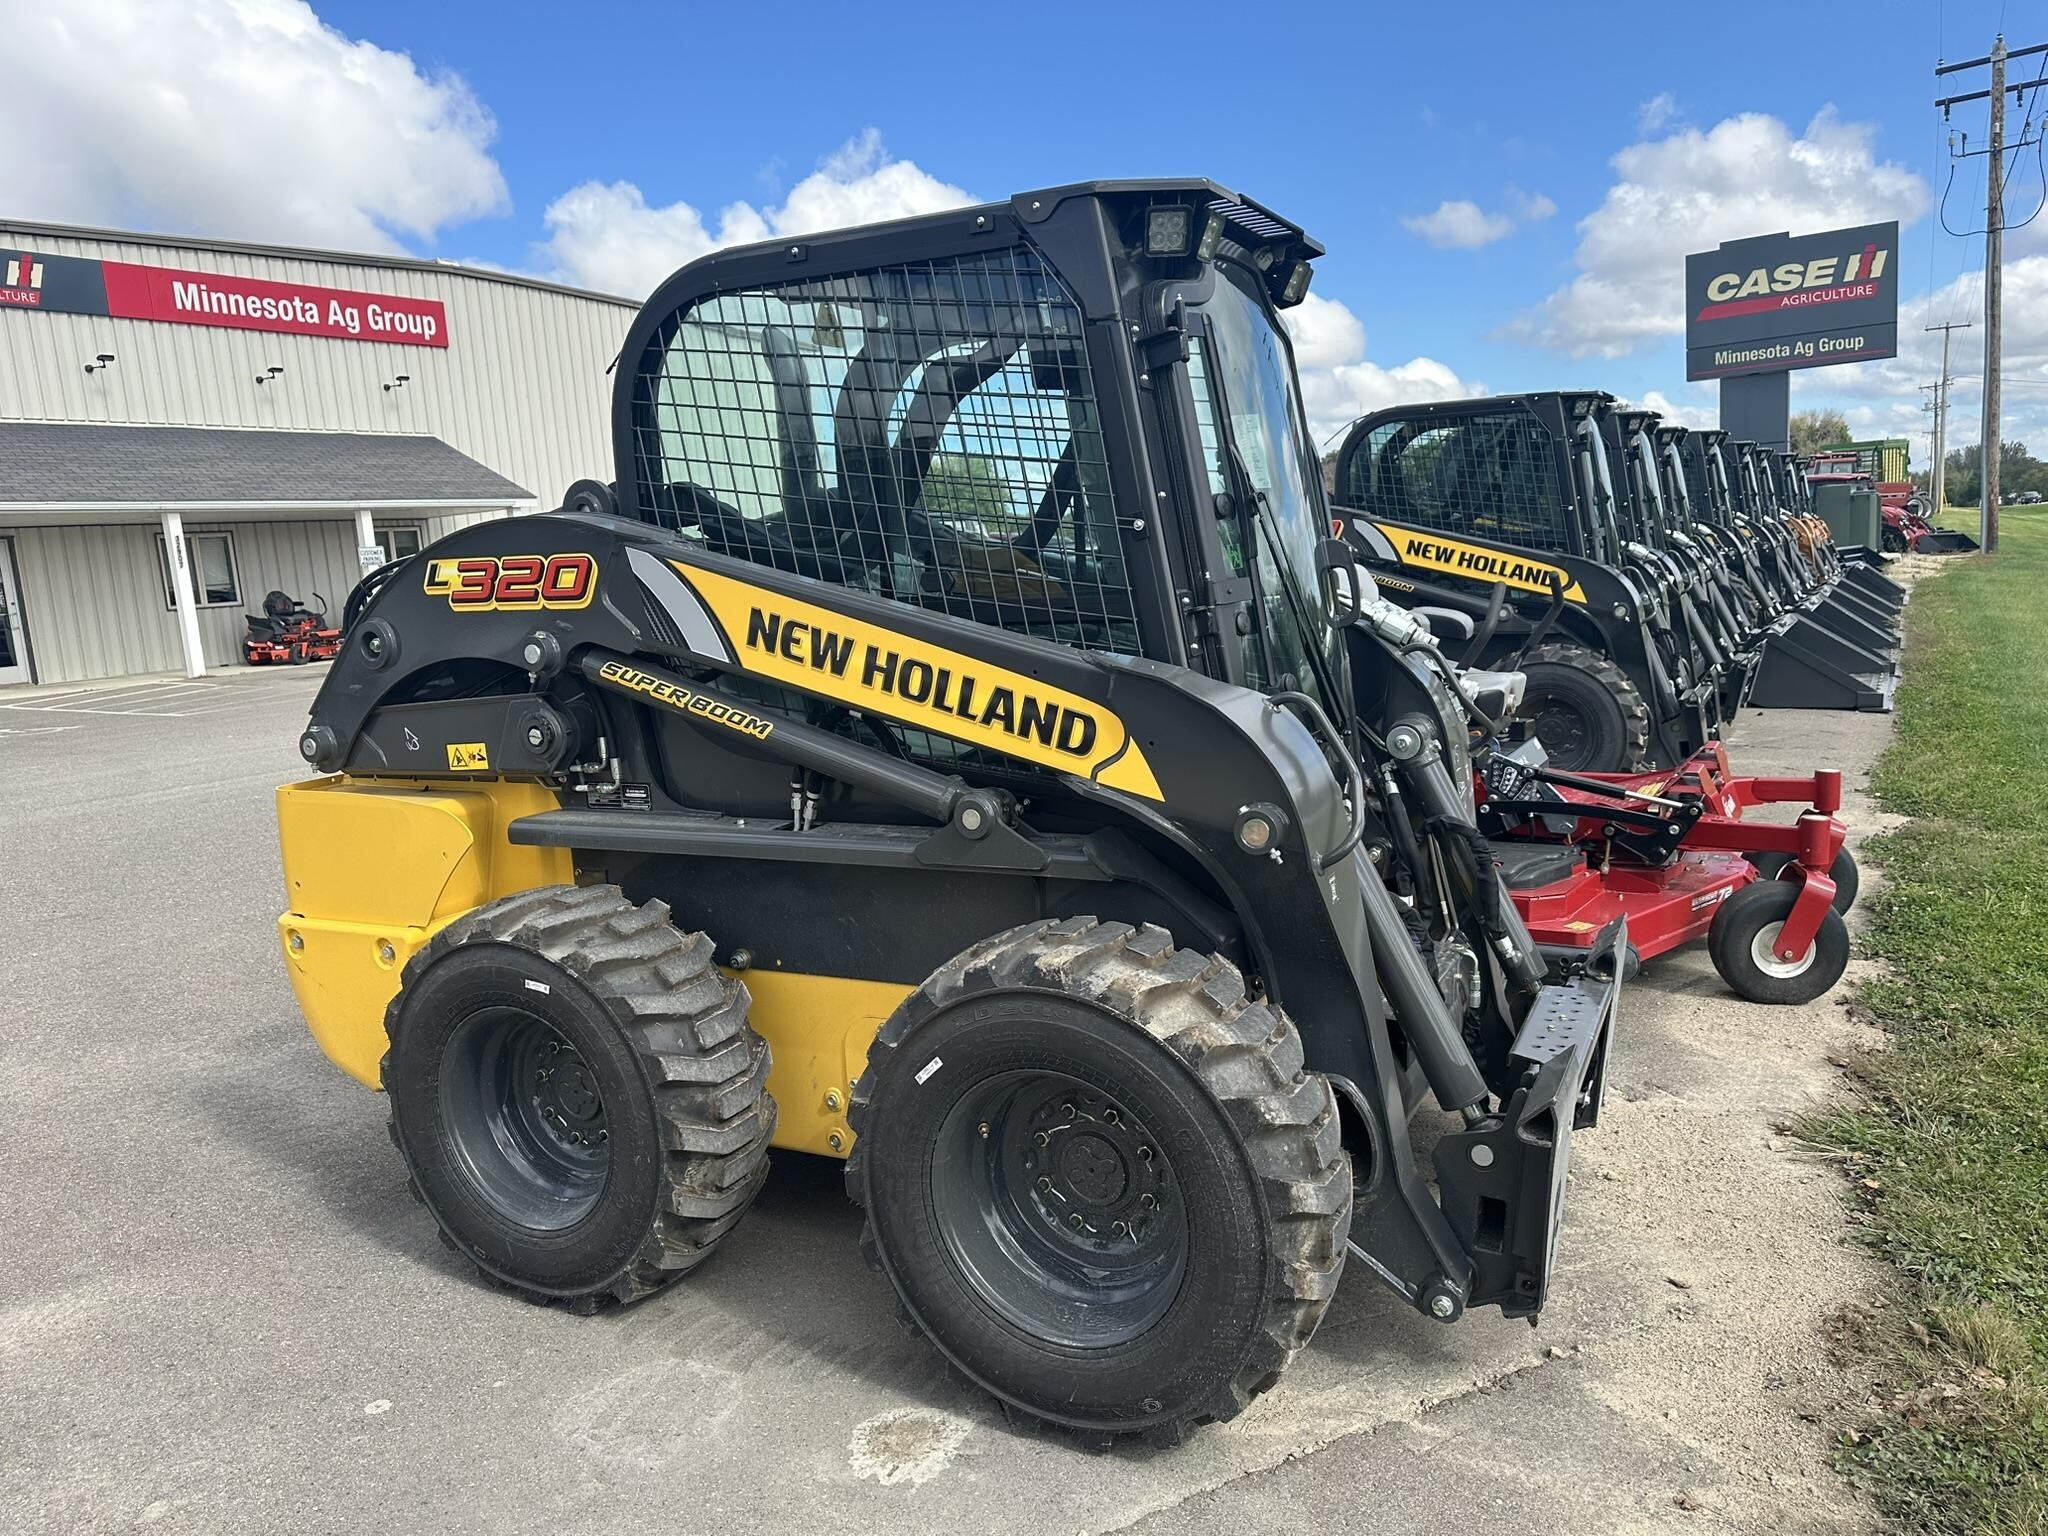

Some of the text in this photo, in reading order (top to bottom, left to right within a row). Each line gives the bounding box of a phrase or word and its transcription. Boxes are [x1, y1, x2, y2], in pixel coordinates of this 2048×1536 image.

[1707, 257, 1838, 302] CASE
[1780, 284, 1873, 307] AGRICULTURE
[171, 281, 437, 341] Minnesota Ag Group
[1715, 336, 1864, 366] Minnesota Ag Group
[425, 554, 595, 608] L320
[1405, 539, 1552, 588] NEW HOLLAND
[601, 662, 773, 740] SUPER BOOM
[745, 606, 1098, 759] NEW HOLLAND
